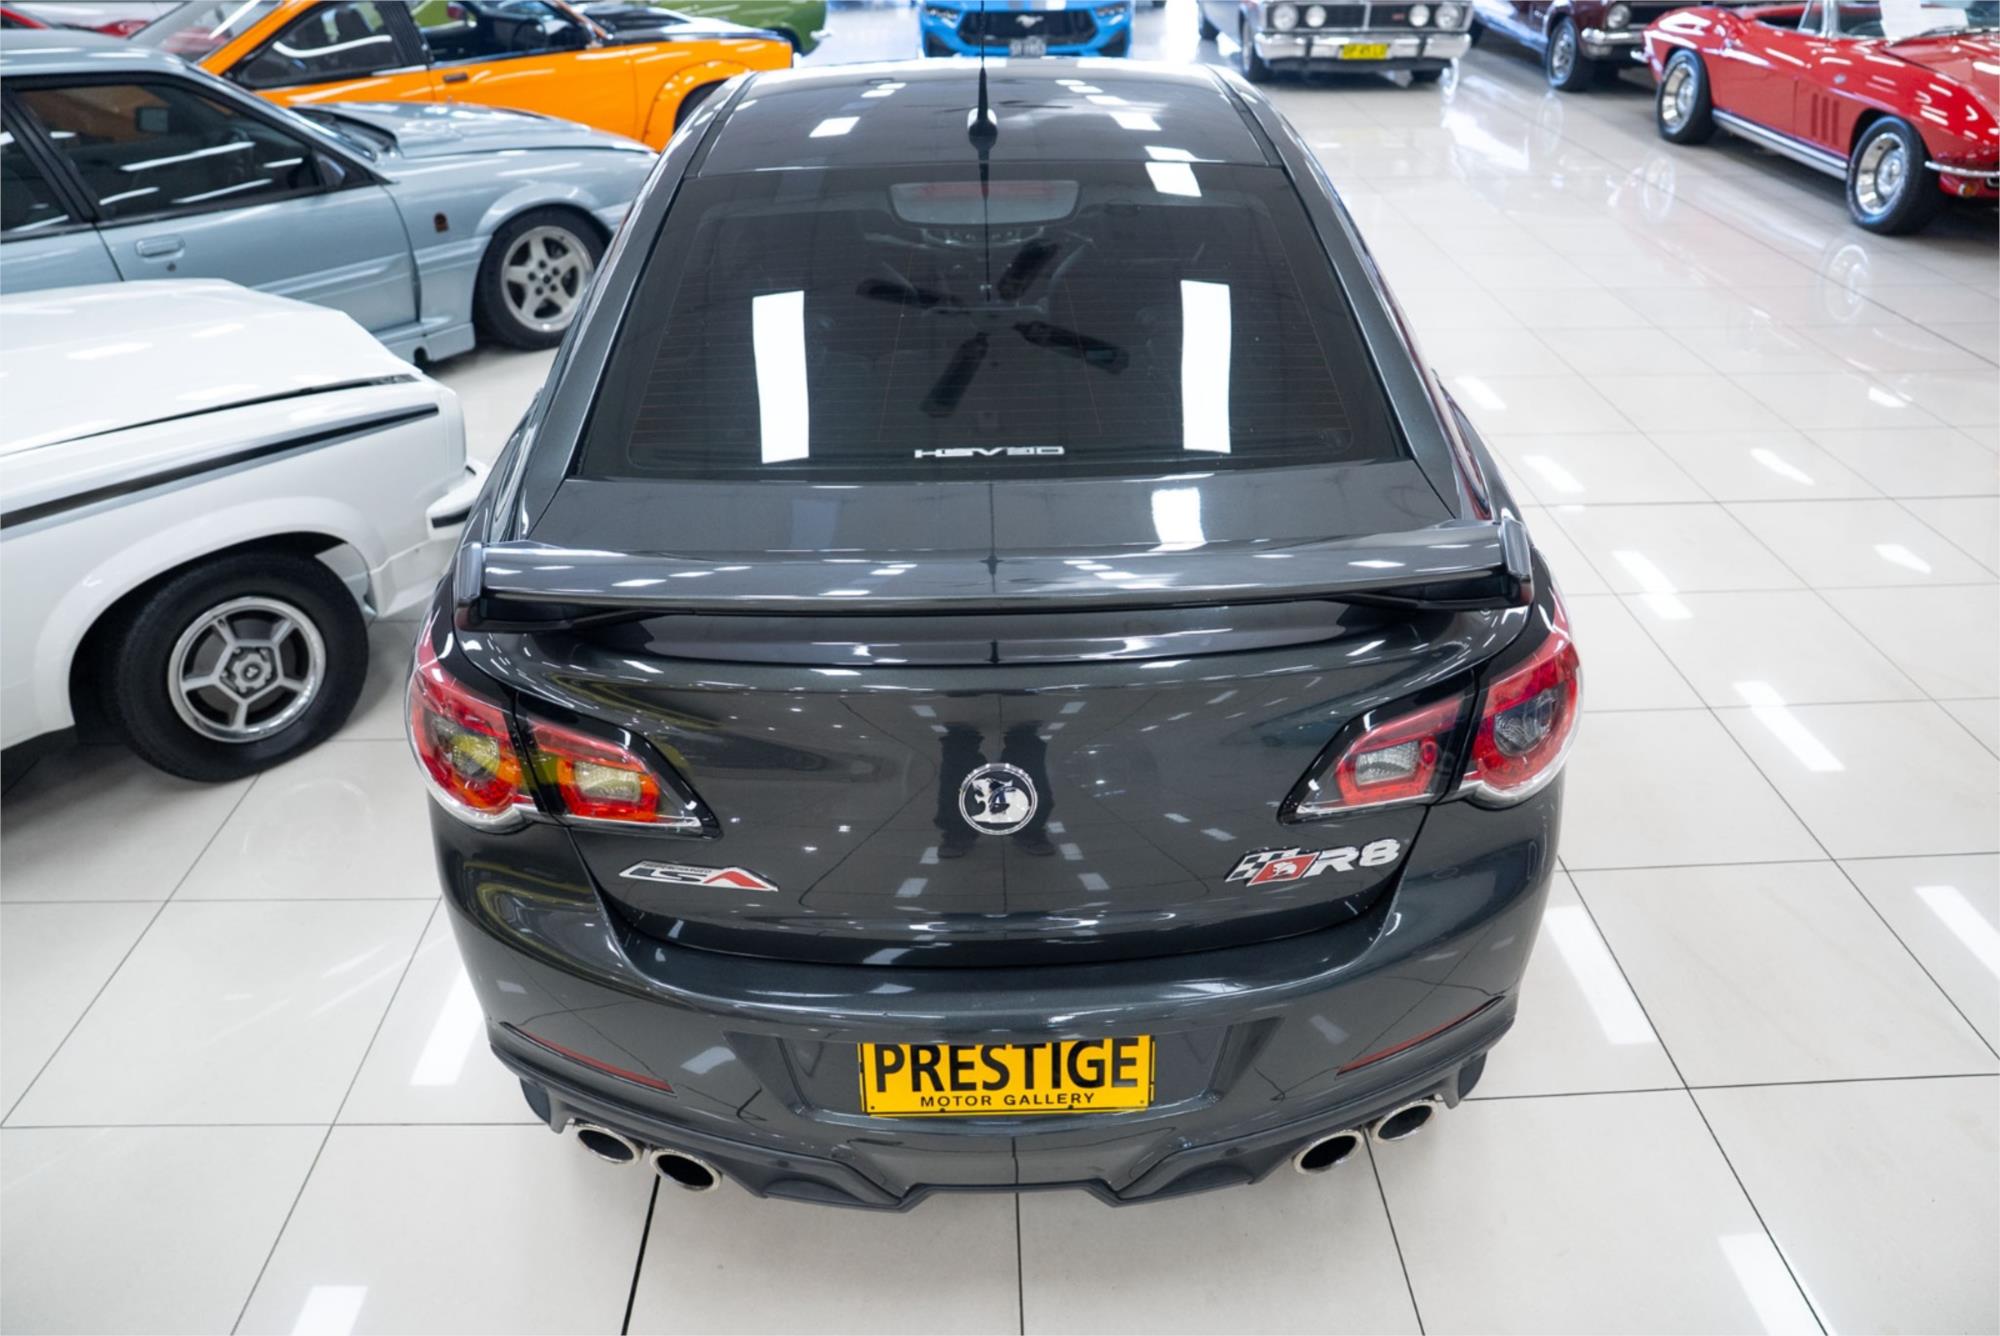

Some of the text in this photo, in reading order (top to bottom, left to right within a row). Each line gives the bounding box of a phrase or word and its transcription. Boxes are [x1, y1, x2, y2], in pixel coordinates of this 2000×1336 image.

[1302, 839, 1400, 878] R8
[875, 1039, 1139, 1093] PRESTIGE
[920, 1093, 1095, 1108] MOTOR GALLERY
